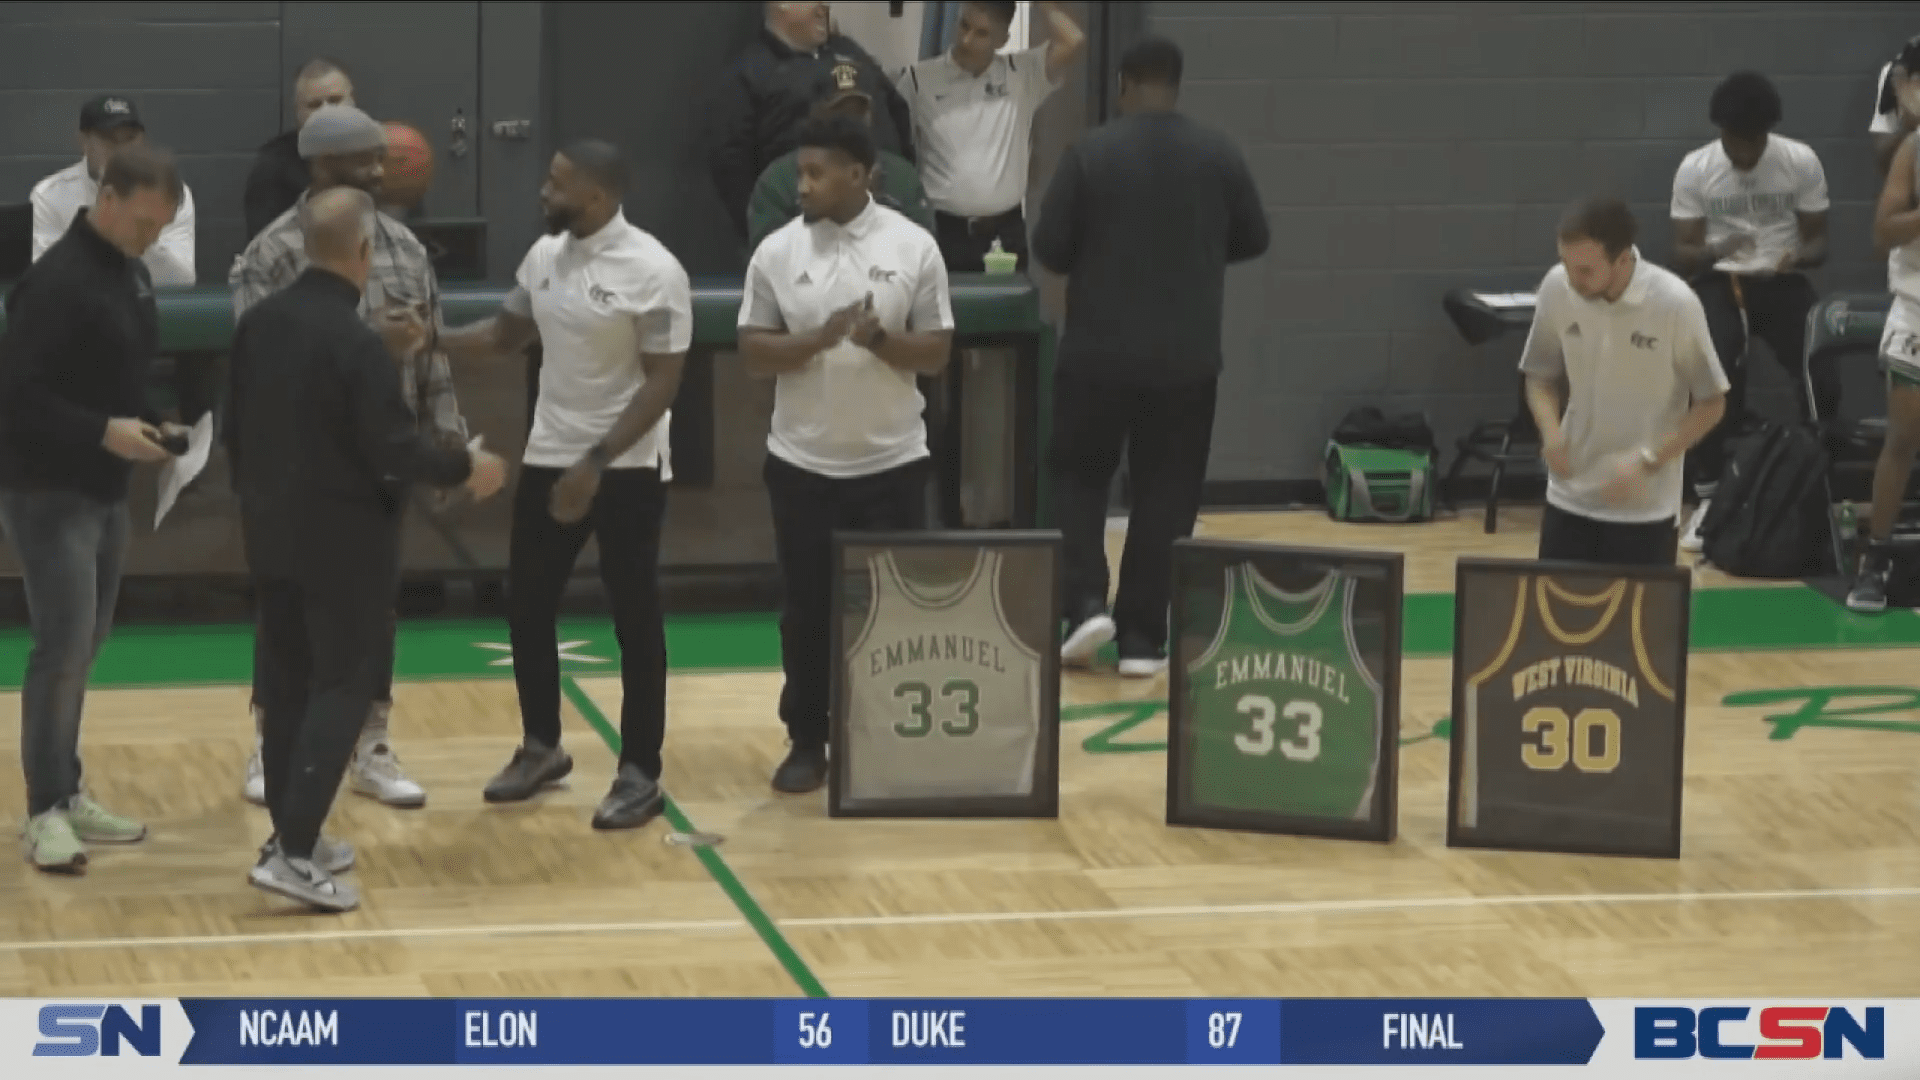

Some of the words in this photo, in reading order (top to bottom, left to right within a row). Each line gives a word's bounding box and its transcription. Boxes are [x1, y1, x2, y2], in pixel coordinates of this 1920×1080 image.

[871, 634, 1005, 677] EMMANUEL
[1215, 653, 1350, 704] EMMANUEL
[1512, 656, 1561, 701] WEST
[1564, 654, 1639, 708] VIRGINIA
[893, 679, 979, 737] 33
[1233, 694, 1323, 762] 33
[1521, 707, 1621, 773] 30
